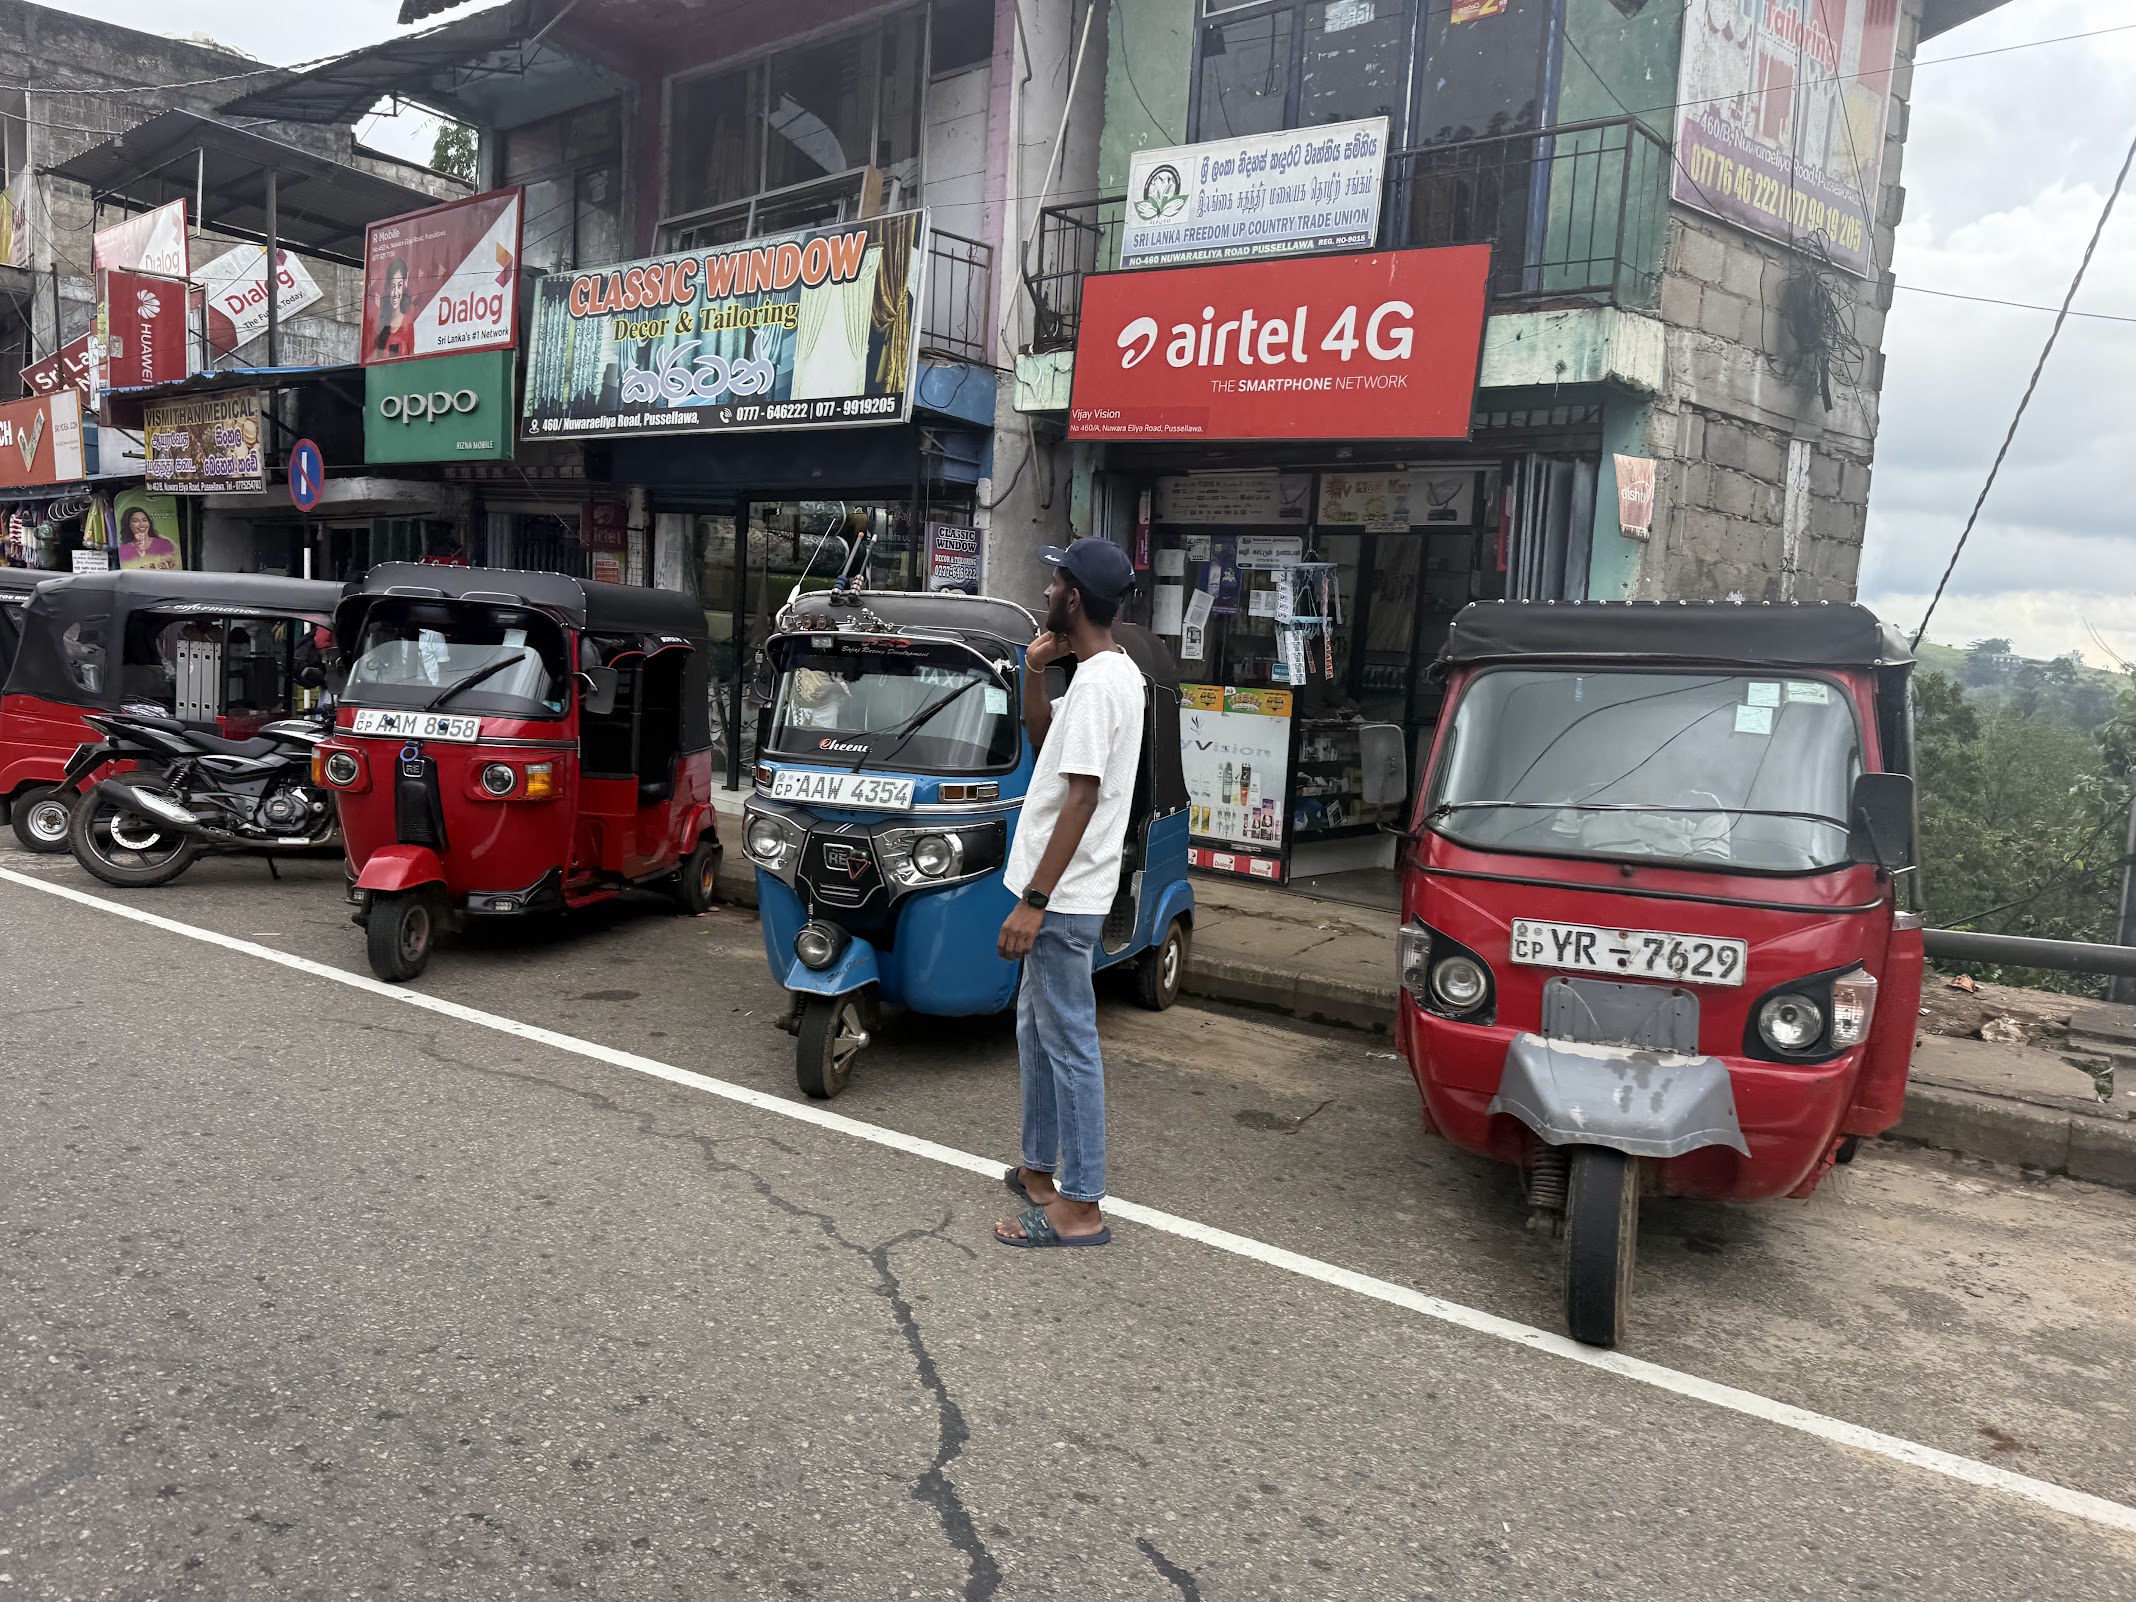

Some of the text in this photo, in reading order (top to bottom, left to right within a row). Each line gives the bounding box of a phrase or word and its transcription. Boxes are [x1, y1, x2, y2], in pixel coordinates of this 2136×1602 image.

[1765, 0, 1838, 75] Tailoring
[1211, 158, 1236, 183] ලංකා
[1196, 188, 1233, 218] இலங்கை
[1690, 143, 1715, 187] 077
[1717, 156, 1733, 196] 76
[1733, 164, 1753, 204] 46
[1752, 173, 1778, 216] 222
[1785, 187, 1809, 228] 077
[1807, 198, 1825, 232] 99
[1826, 207, 1840, 242] 19
[1839, 213, 1863, 252] 205
[379, 228, 401, 242] Mobile
[1133, 207, 1370, 248] SRI LANKA FREEDOM UP COUNTRY TRADE UNION
[1129, 234, 1366, 266] NO-460 NUWARAELIYA ROAD PUSSELLAWA REG. NO-9015
[569, 230, 868, 318] CLASSIC WINDOW
[437, 290, 504, 327] Dialog
[243, 318, 259, 329] The
[612, 300, 800, 342] Decor & Tailoring
[437, 326, 509, 346] Sri Lanka's #1 Network
[1165, 299, 1416, 368] airtel 4G
[140, 323, 153, 384] HUAWEI
[1210, 374, 1409, 392] THE SMARTPHONE NETWORK
[144, 398, 255, 428] VISMITHAN MEDICAL
[380, 389, 479, 425] oppo
[1071, 408, 1121, 421] Vijay Vision
[617, 413, 643, 428] Road,
[643, 410, 700, 427] Pussellawa,
[1069, 424, 1079, 432] No
[1102, 424, 1127, 432] Nuwara
[1127, 424, 1143, 433] Eliya
[456, 440, 494, 450] RIZNA MOBILE
[938, 526, 976, 541] CLASSIC
[936, 537, 977, 553] WINDOW
[934, 554, 950, 563] DECOR
[861, 646, 885, 656] Racing
[919, 665, 965, 690] TAXI
[356, 720, 373, 732] CP
[375, 714, 418, 734] AAM
[405, 764, 420, 774] RE
[774, 774, 908, 806] CP AAW 4354
[828, 851, 848, 866] RE
[1214, 860, 1269, 875] Dialog Dialog
[1515, 939, 1545, 960] CP
[1550, 928, 1597, 966] YR
[1642, 937, 1740, 980] 7629
